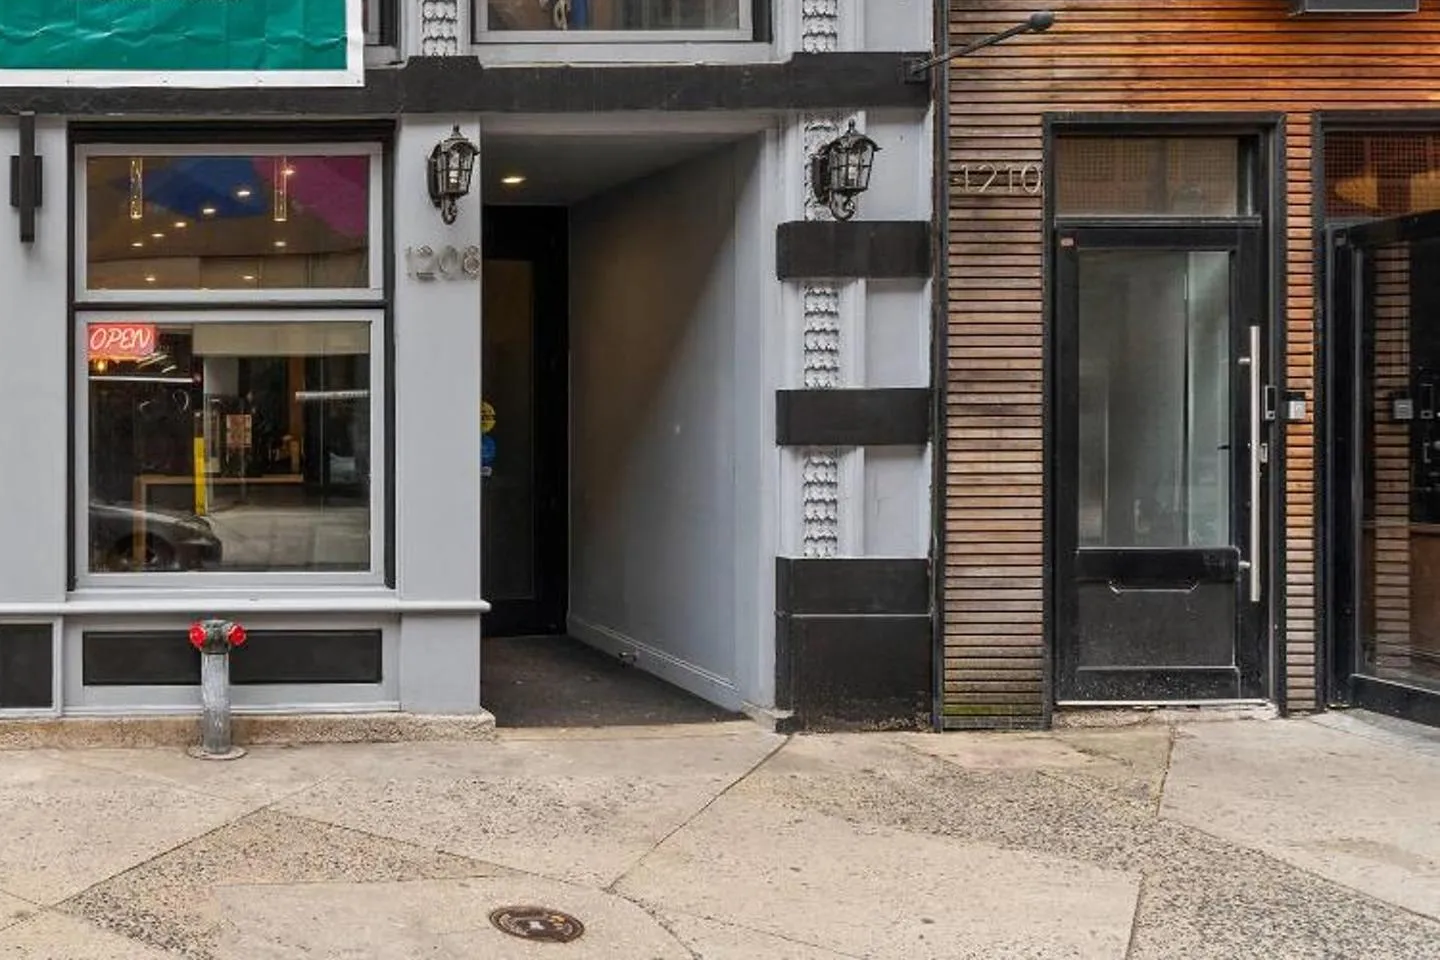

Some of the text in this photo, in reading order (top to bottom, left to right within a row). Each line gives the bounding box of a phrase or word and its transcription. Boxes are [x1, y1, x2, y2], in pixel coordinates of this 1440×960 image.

[961, 163, 1042, 194] 1210
[405, 244, 480, 281] 1208
[90, 327, 151, 351] OPEN
